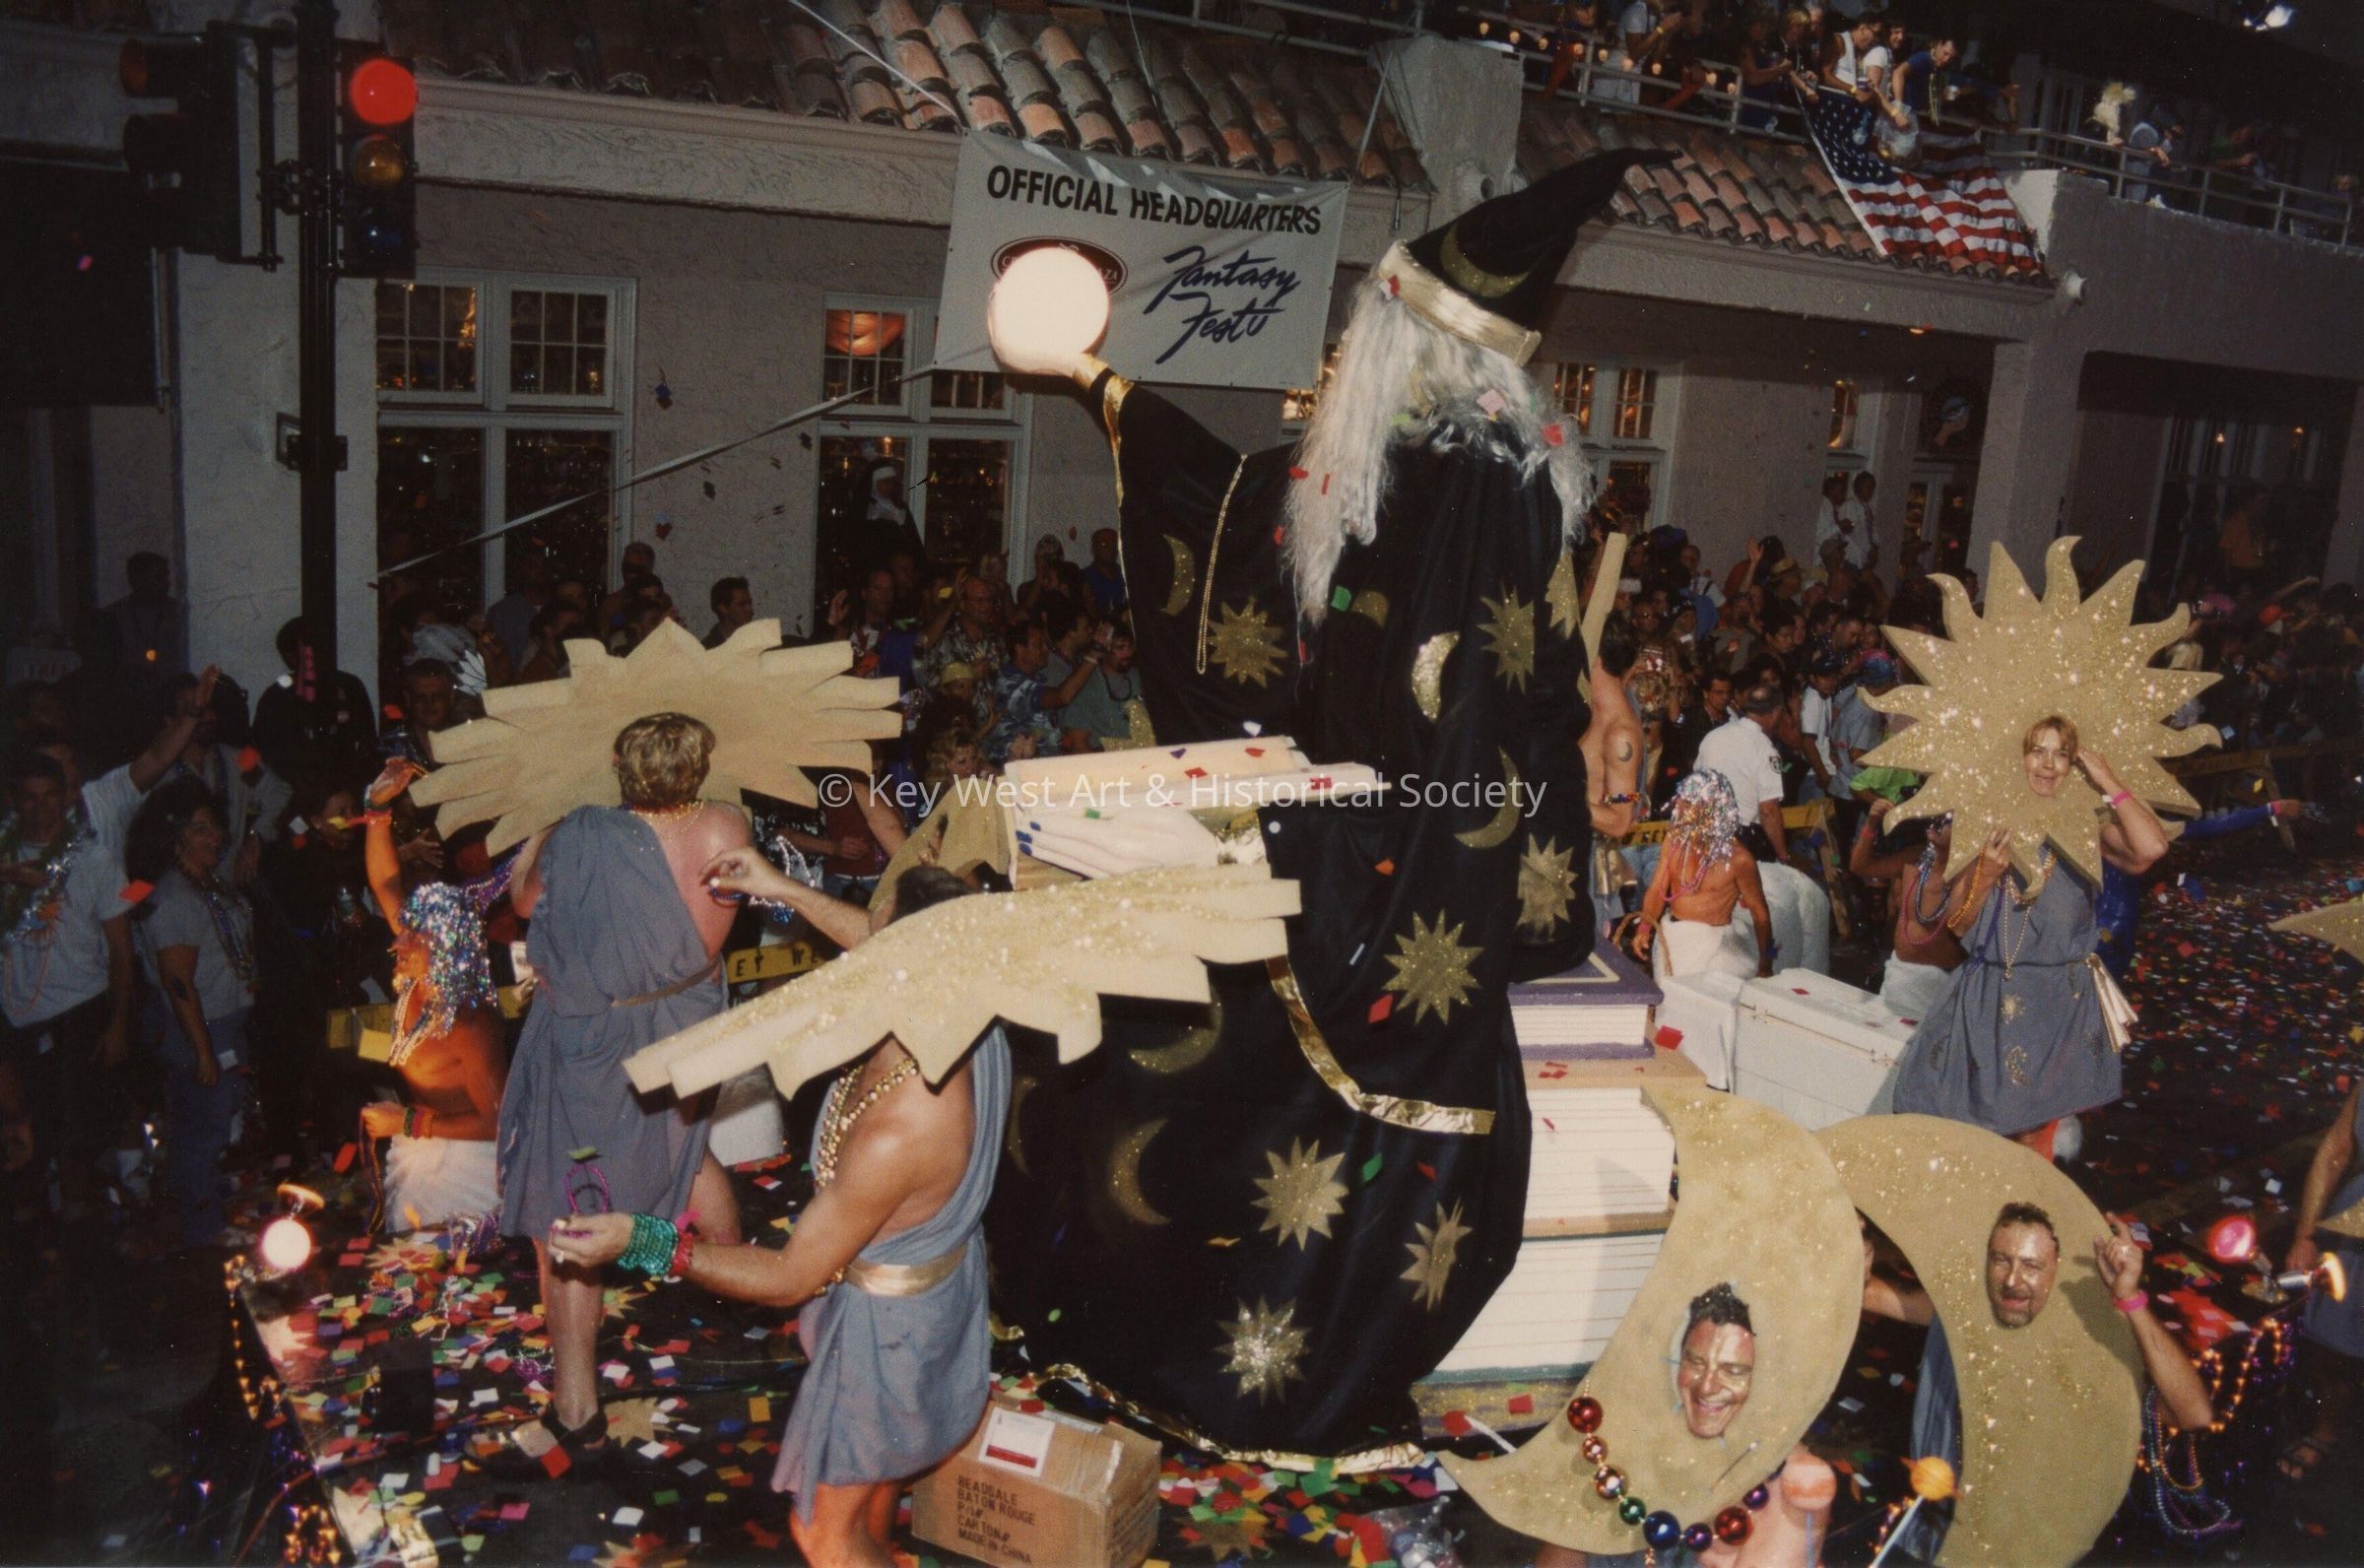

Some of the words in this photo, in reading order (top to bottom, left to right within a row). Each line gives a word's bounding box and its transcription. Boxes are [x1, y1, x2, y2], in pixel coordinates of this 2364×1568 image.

[987, 164, 1118, 216] OFFICIAL
[1129, 187, 1322, 235] HEADQUARTERS
[1143, 245, 1301, 336] Fantasy
[957, 1487, 996, 1511] BATON
[999, 1502, 1036, 1527] ROUGE
[1002, 1543, 1032, 1564] CHINA
